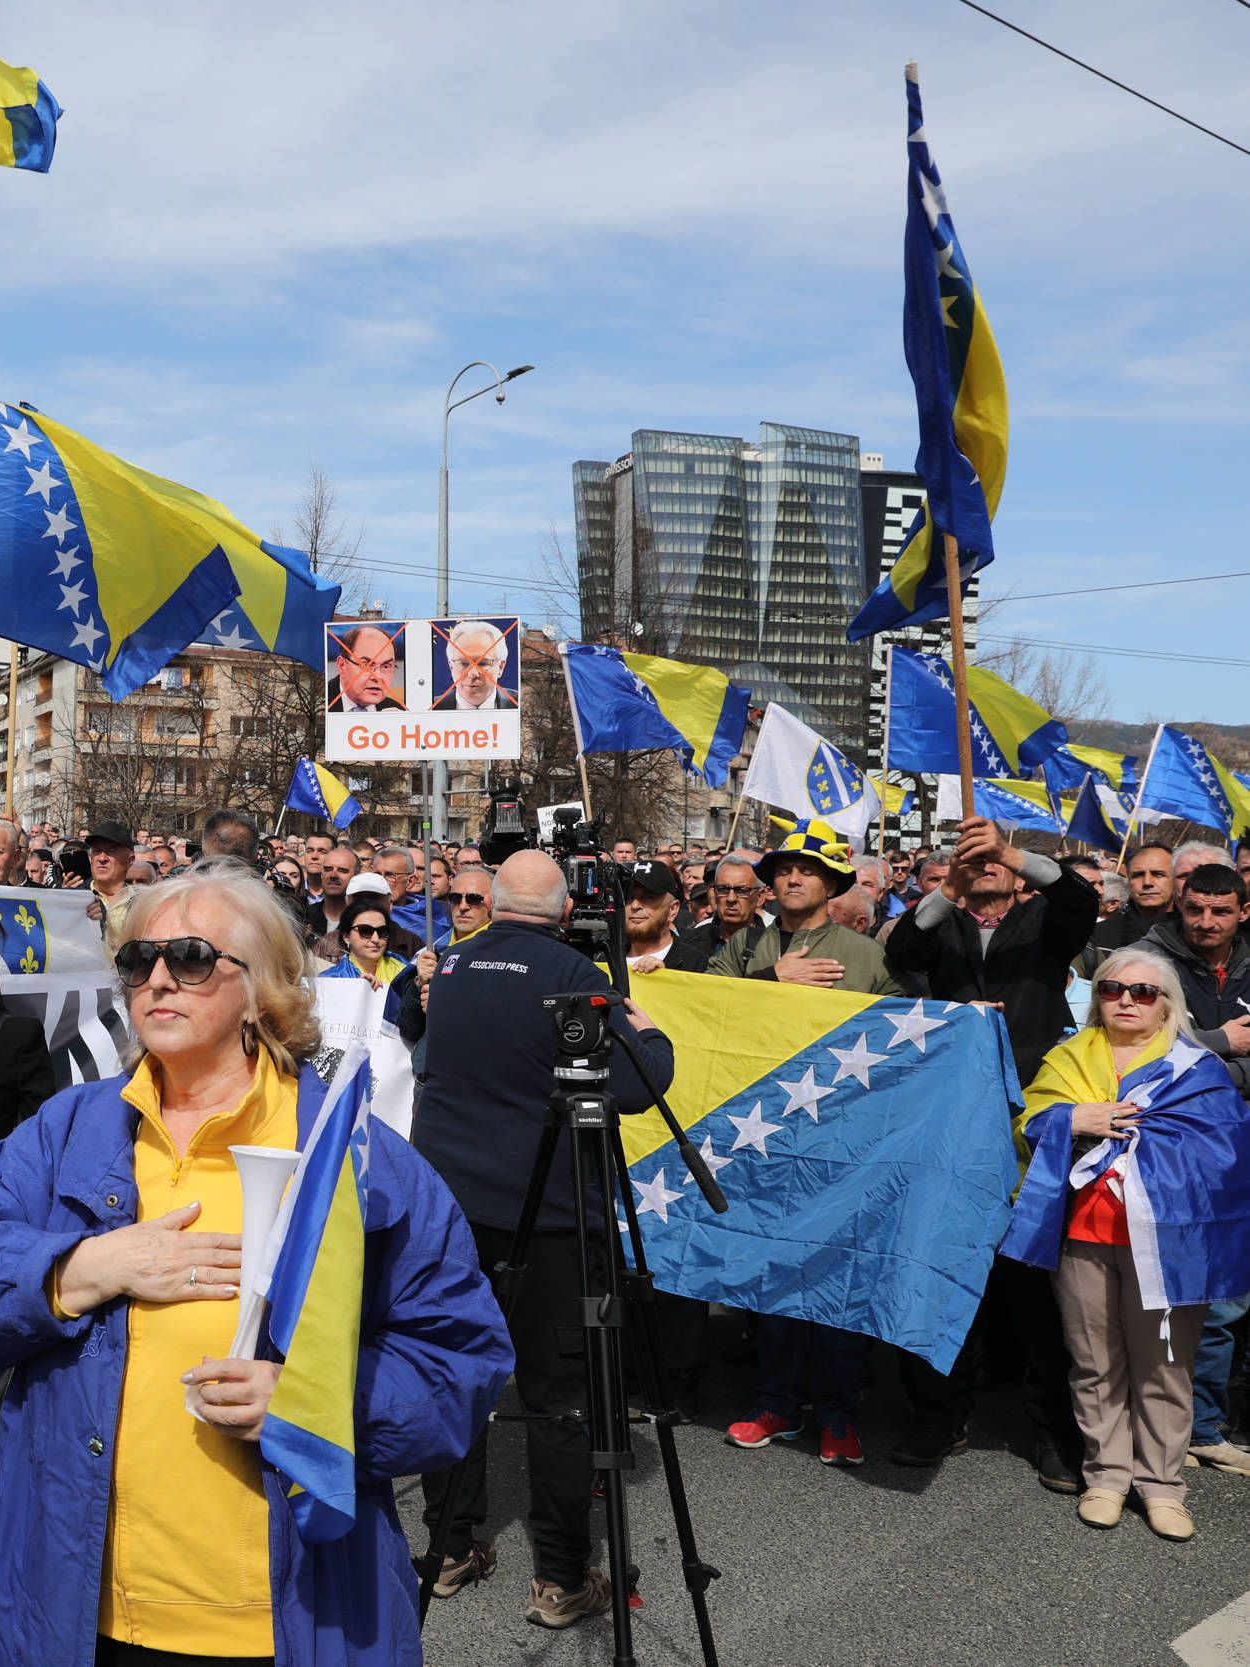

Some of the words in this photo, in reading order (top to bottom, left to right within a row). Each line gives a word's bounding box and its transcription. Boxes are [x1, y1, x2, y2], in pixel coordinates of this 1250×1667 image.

[347, 725, 390, 750] Go
[400, 723, 499, 749] Home!
[469, 960, 506, 970] ASSOCIATED
[505, 962, 529, 974] PRESS
